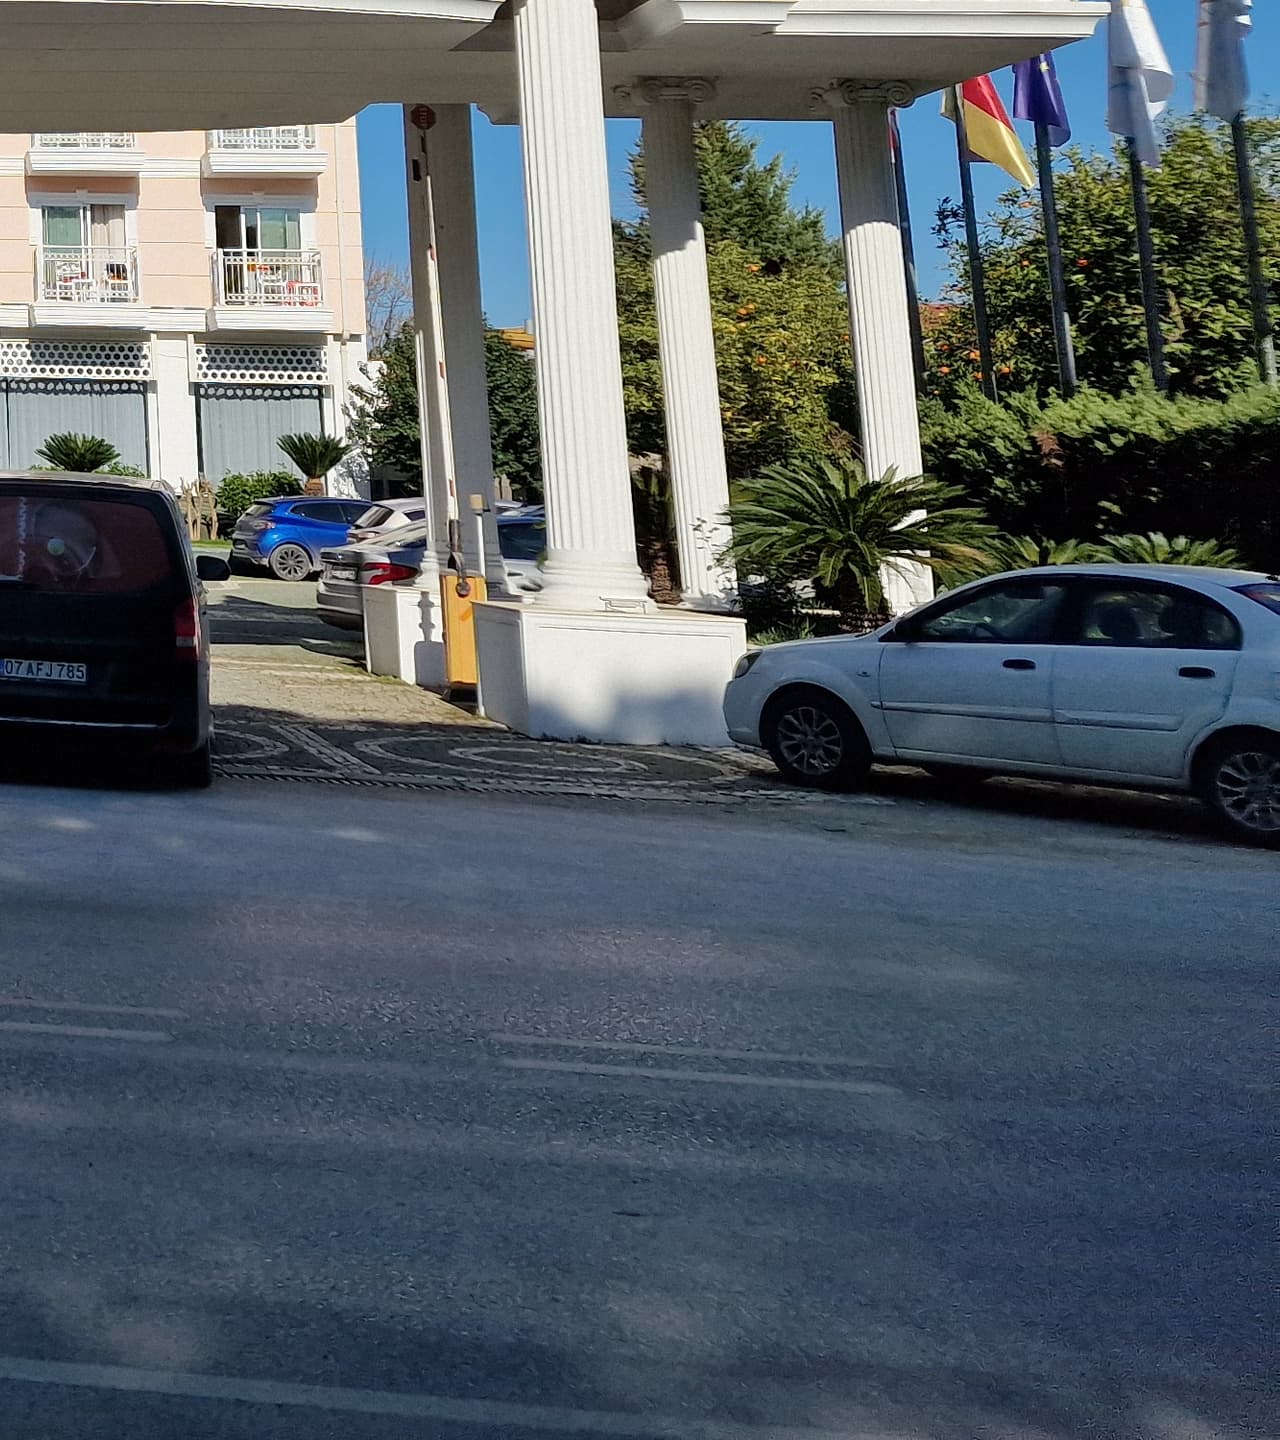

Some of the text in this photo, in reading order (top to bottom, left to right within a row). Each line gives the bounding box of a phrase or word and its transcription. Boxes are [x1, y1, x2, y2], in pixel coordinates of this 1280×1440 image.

[5, 660, 85, 679] 07 AFJ 785
